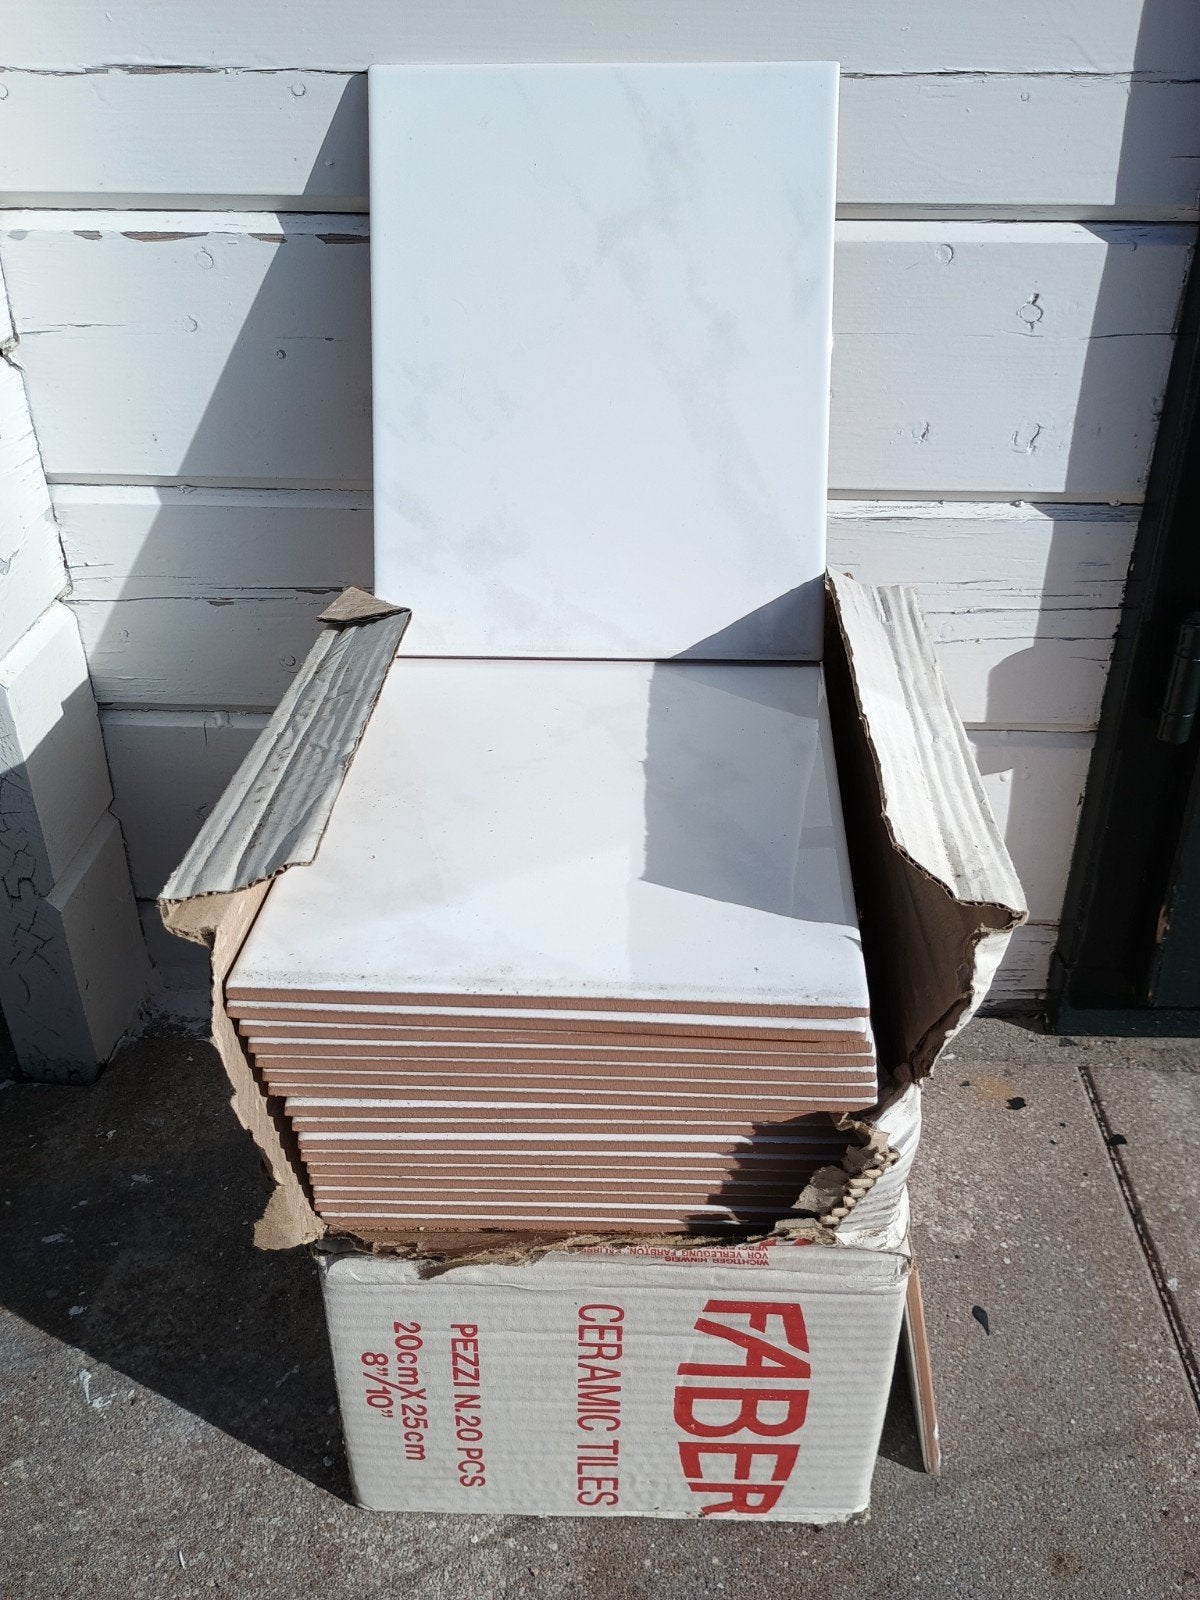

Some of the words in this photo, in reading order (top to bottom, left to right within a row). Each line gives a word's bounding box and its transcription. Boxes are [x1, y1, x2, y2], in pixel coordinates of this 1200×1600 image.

[681, 1249, 742, 1258] VERLEGUNG
[712, 1257, 769, 1266] WICHTIGER
[747, 1251, 768, 1259] VOR
[450, 1324, 480, 1387] PEZZI
[577, 1304, 624, 1432] CERAMIC
[673, 1300, 812, 1516] FABER
[456, 1447, 486, 1488] PCS
[577, 1440, 620, 1506] TILES
